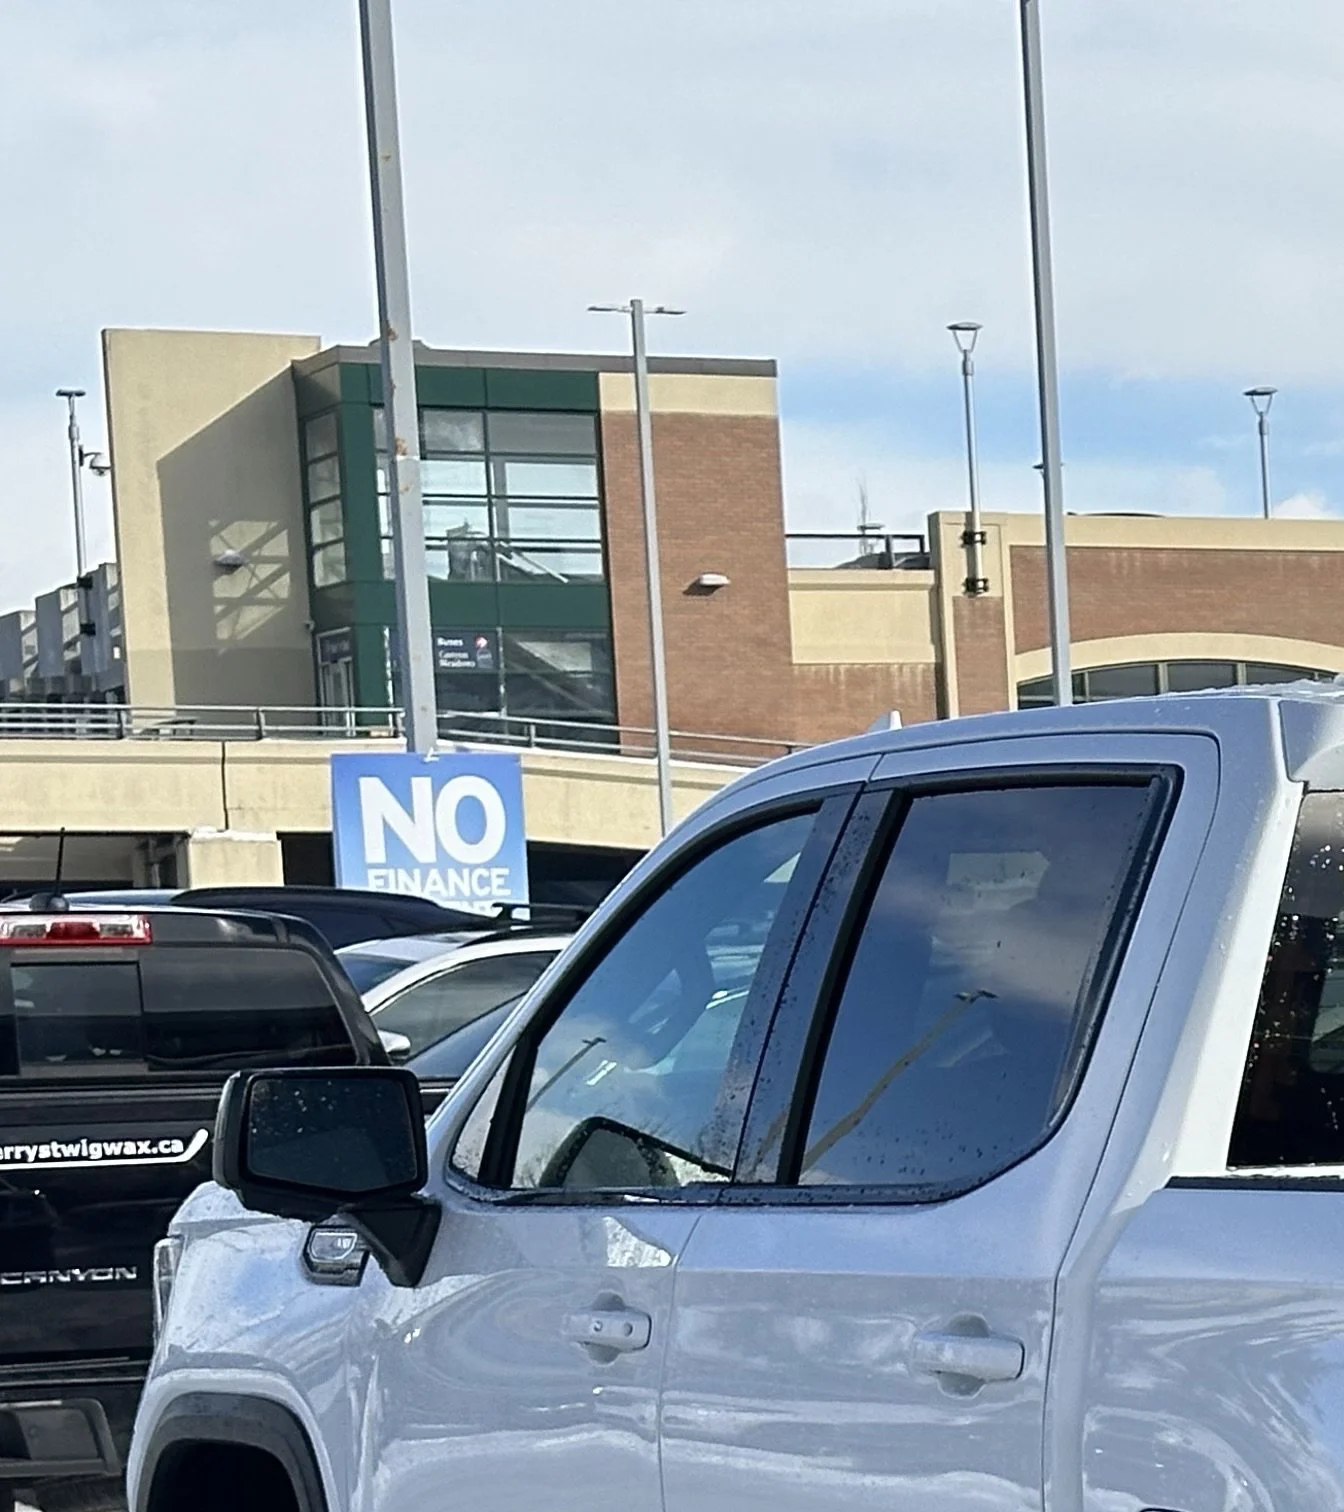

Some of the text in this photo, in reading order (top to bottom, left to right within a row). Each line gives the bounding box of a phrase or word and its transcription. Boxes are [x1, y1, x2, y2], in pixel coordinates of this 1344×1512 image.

[358, 774, 507, 865] NO
[367, 867, 512, 897] FINANCE
[0, 1266, 138, 1285] CANYON
